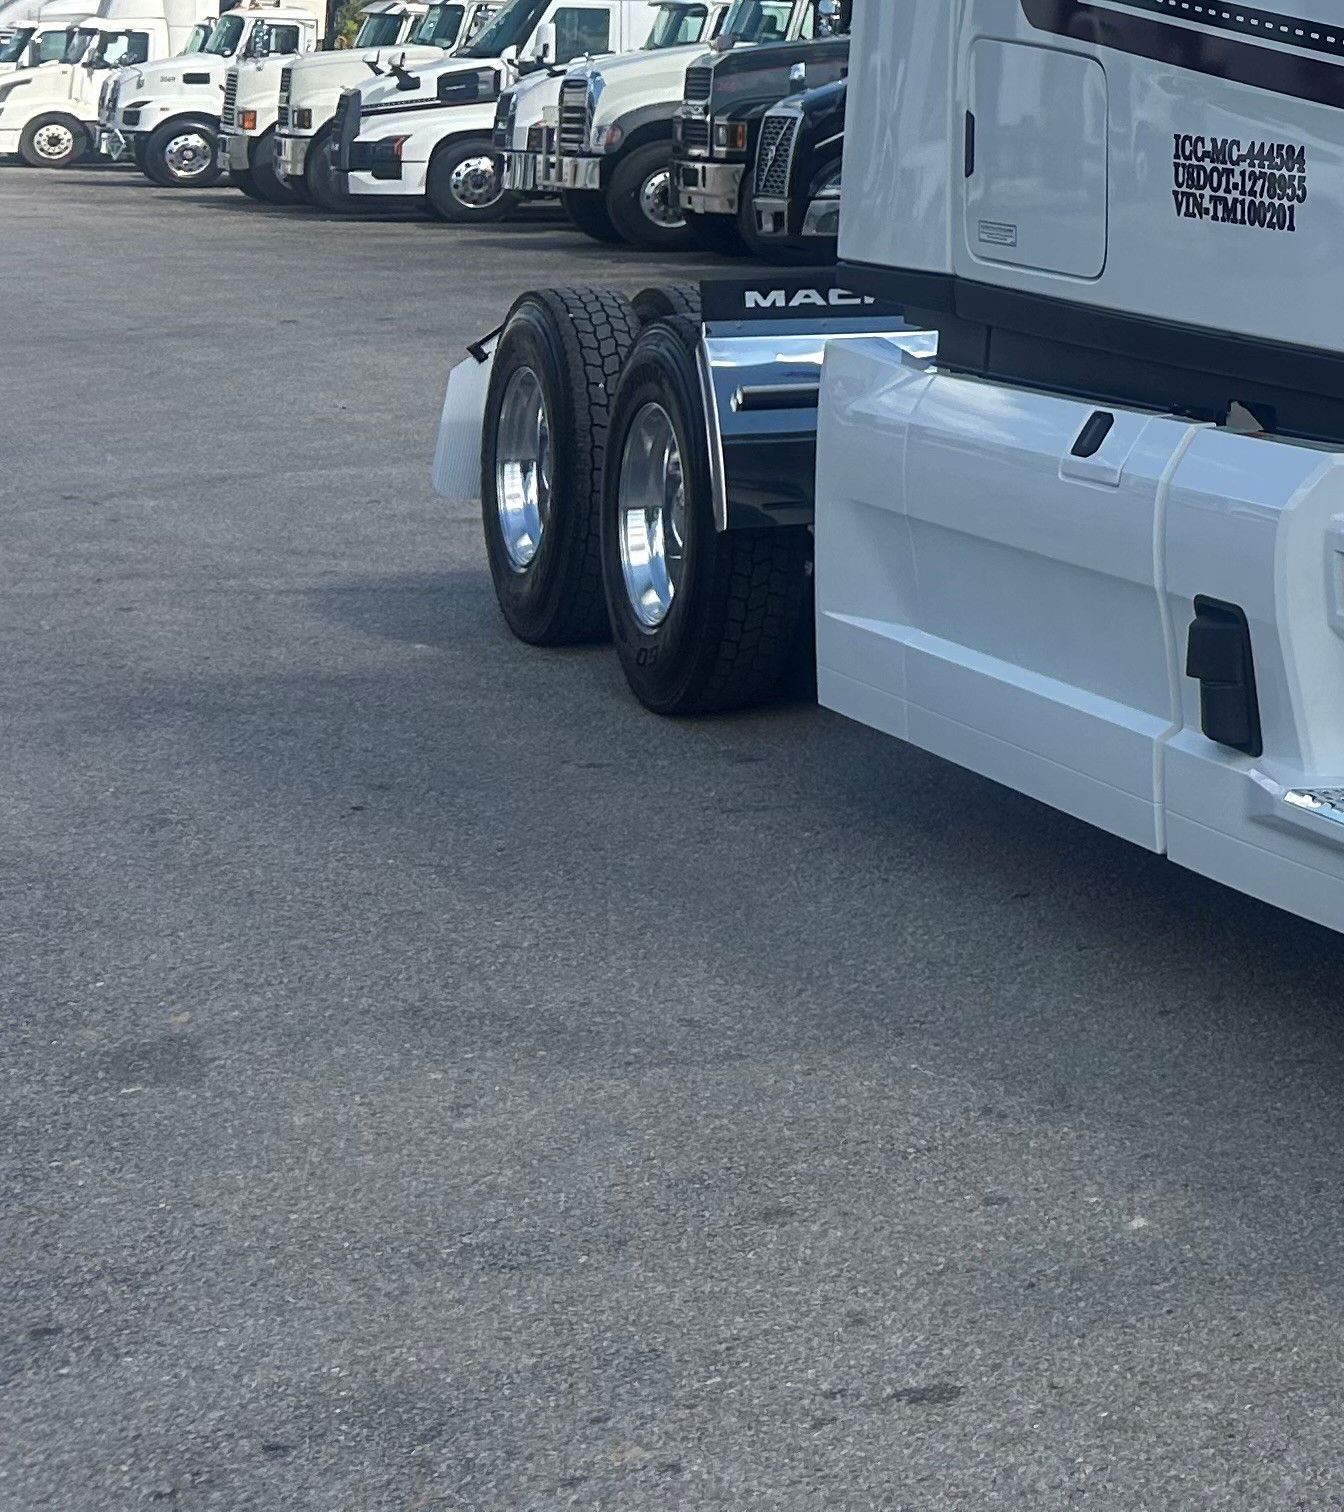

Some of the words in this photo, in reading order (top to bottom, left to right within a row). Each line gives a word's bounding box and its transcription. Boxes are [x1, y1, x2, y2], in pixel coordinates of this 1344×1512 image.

[1172, 161, 1308, 204] USDOT-1278955
[1171, 189, 1296, 232] VIN-TM100201
[744, 288, 876, 308] MAC
